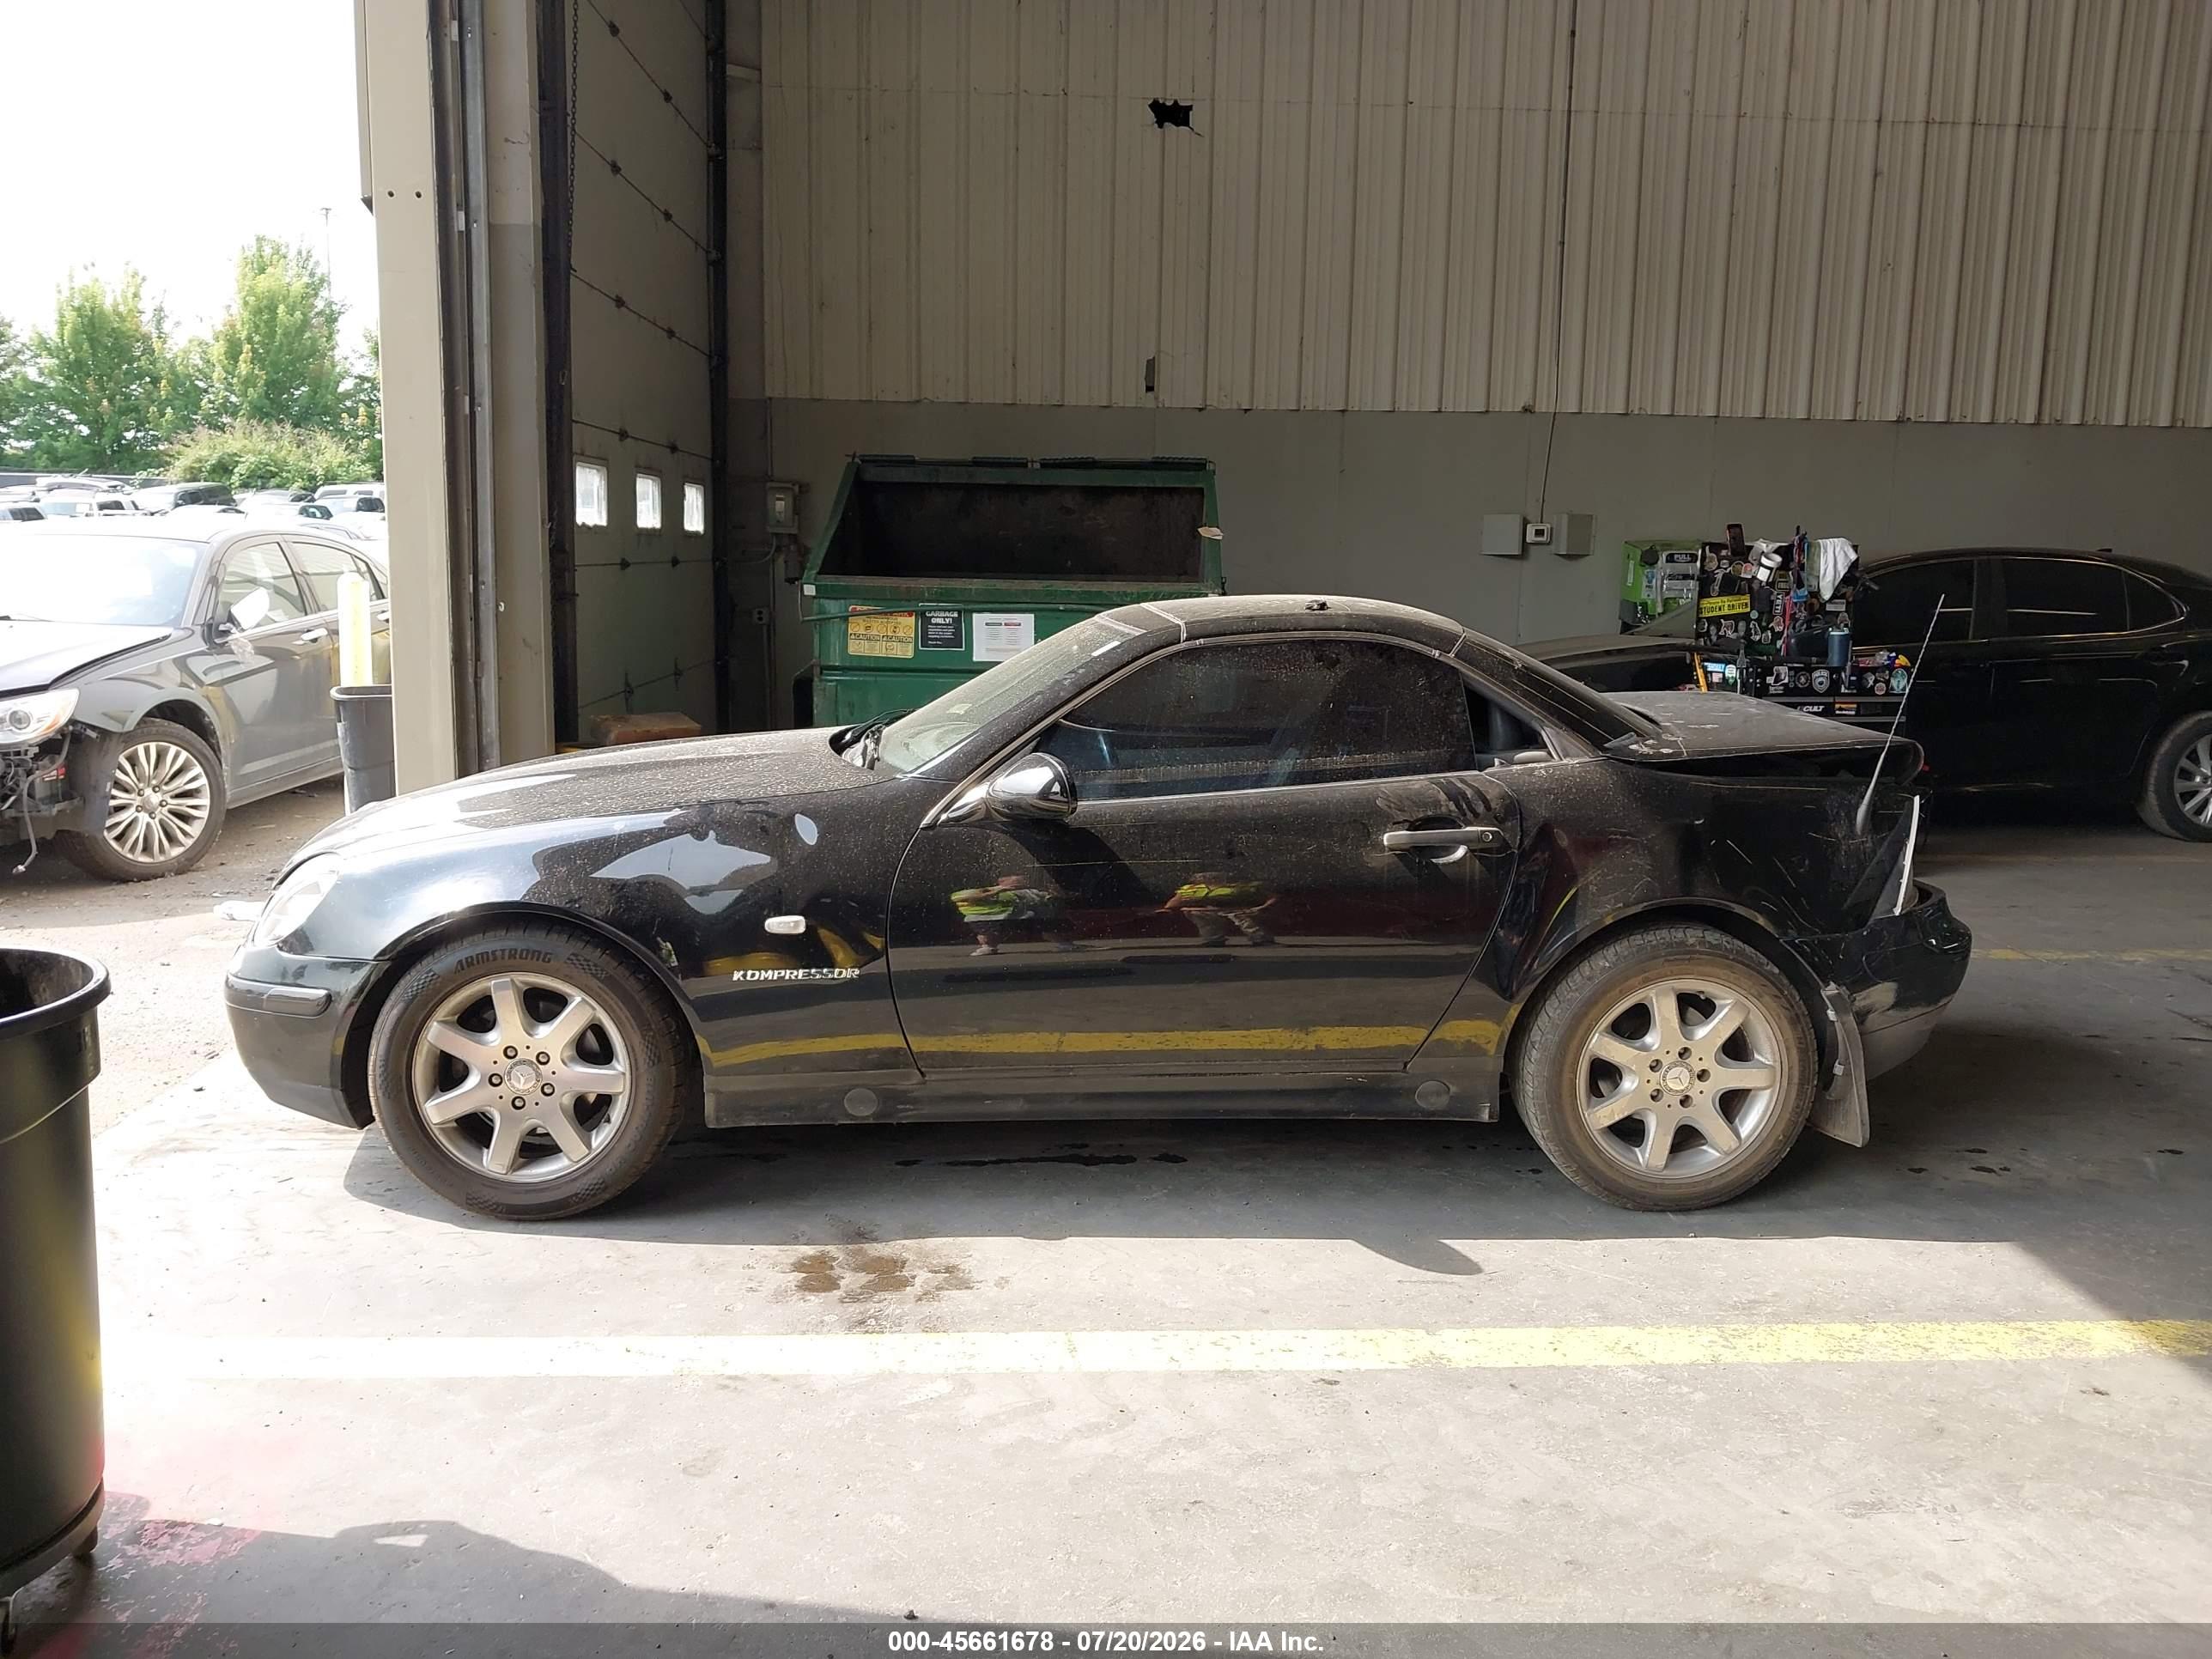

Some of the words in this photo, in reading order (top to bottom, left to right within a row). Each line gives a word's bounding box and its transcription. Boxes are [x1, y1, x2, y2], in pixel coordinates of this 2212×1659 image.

[1700, 604, 1725, 615] STUDENT
[1727, 602, 1748, 611] DRIVER
[453, 948, 553, 974] ARMSTRONG
[732, 968, 860, 981] KOMPRESSOR
